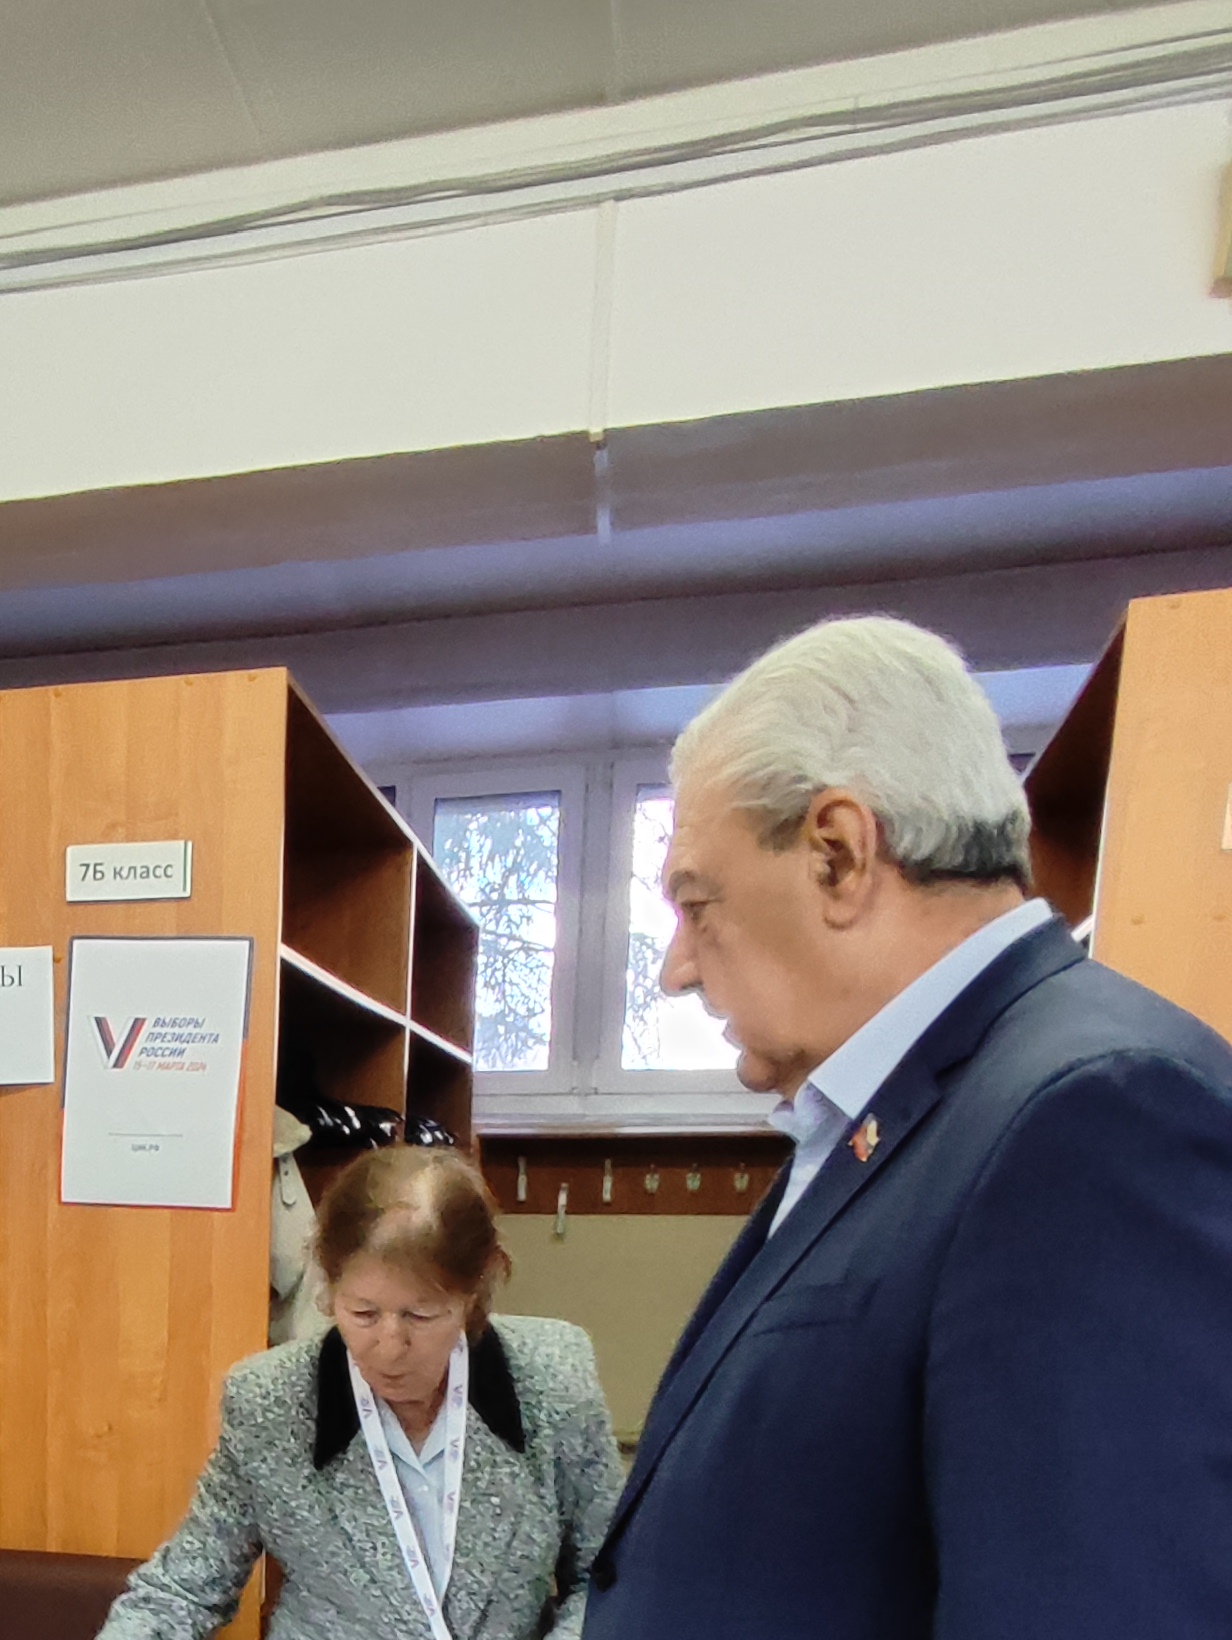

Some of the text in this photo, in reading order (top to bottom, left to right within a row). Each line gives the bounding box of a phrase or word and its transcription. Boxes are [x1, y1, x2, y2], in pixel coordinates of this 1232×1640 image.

[79, 862, 174, 882] 7Б класс
[152, 1016, 206, 1029] ВЫБОРЫ
[145, 1031, 220, 1045] ПРЕЗИДЕНТА
[138, 1046, 187, 1059] РОССИИ
